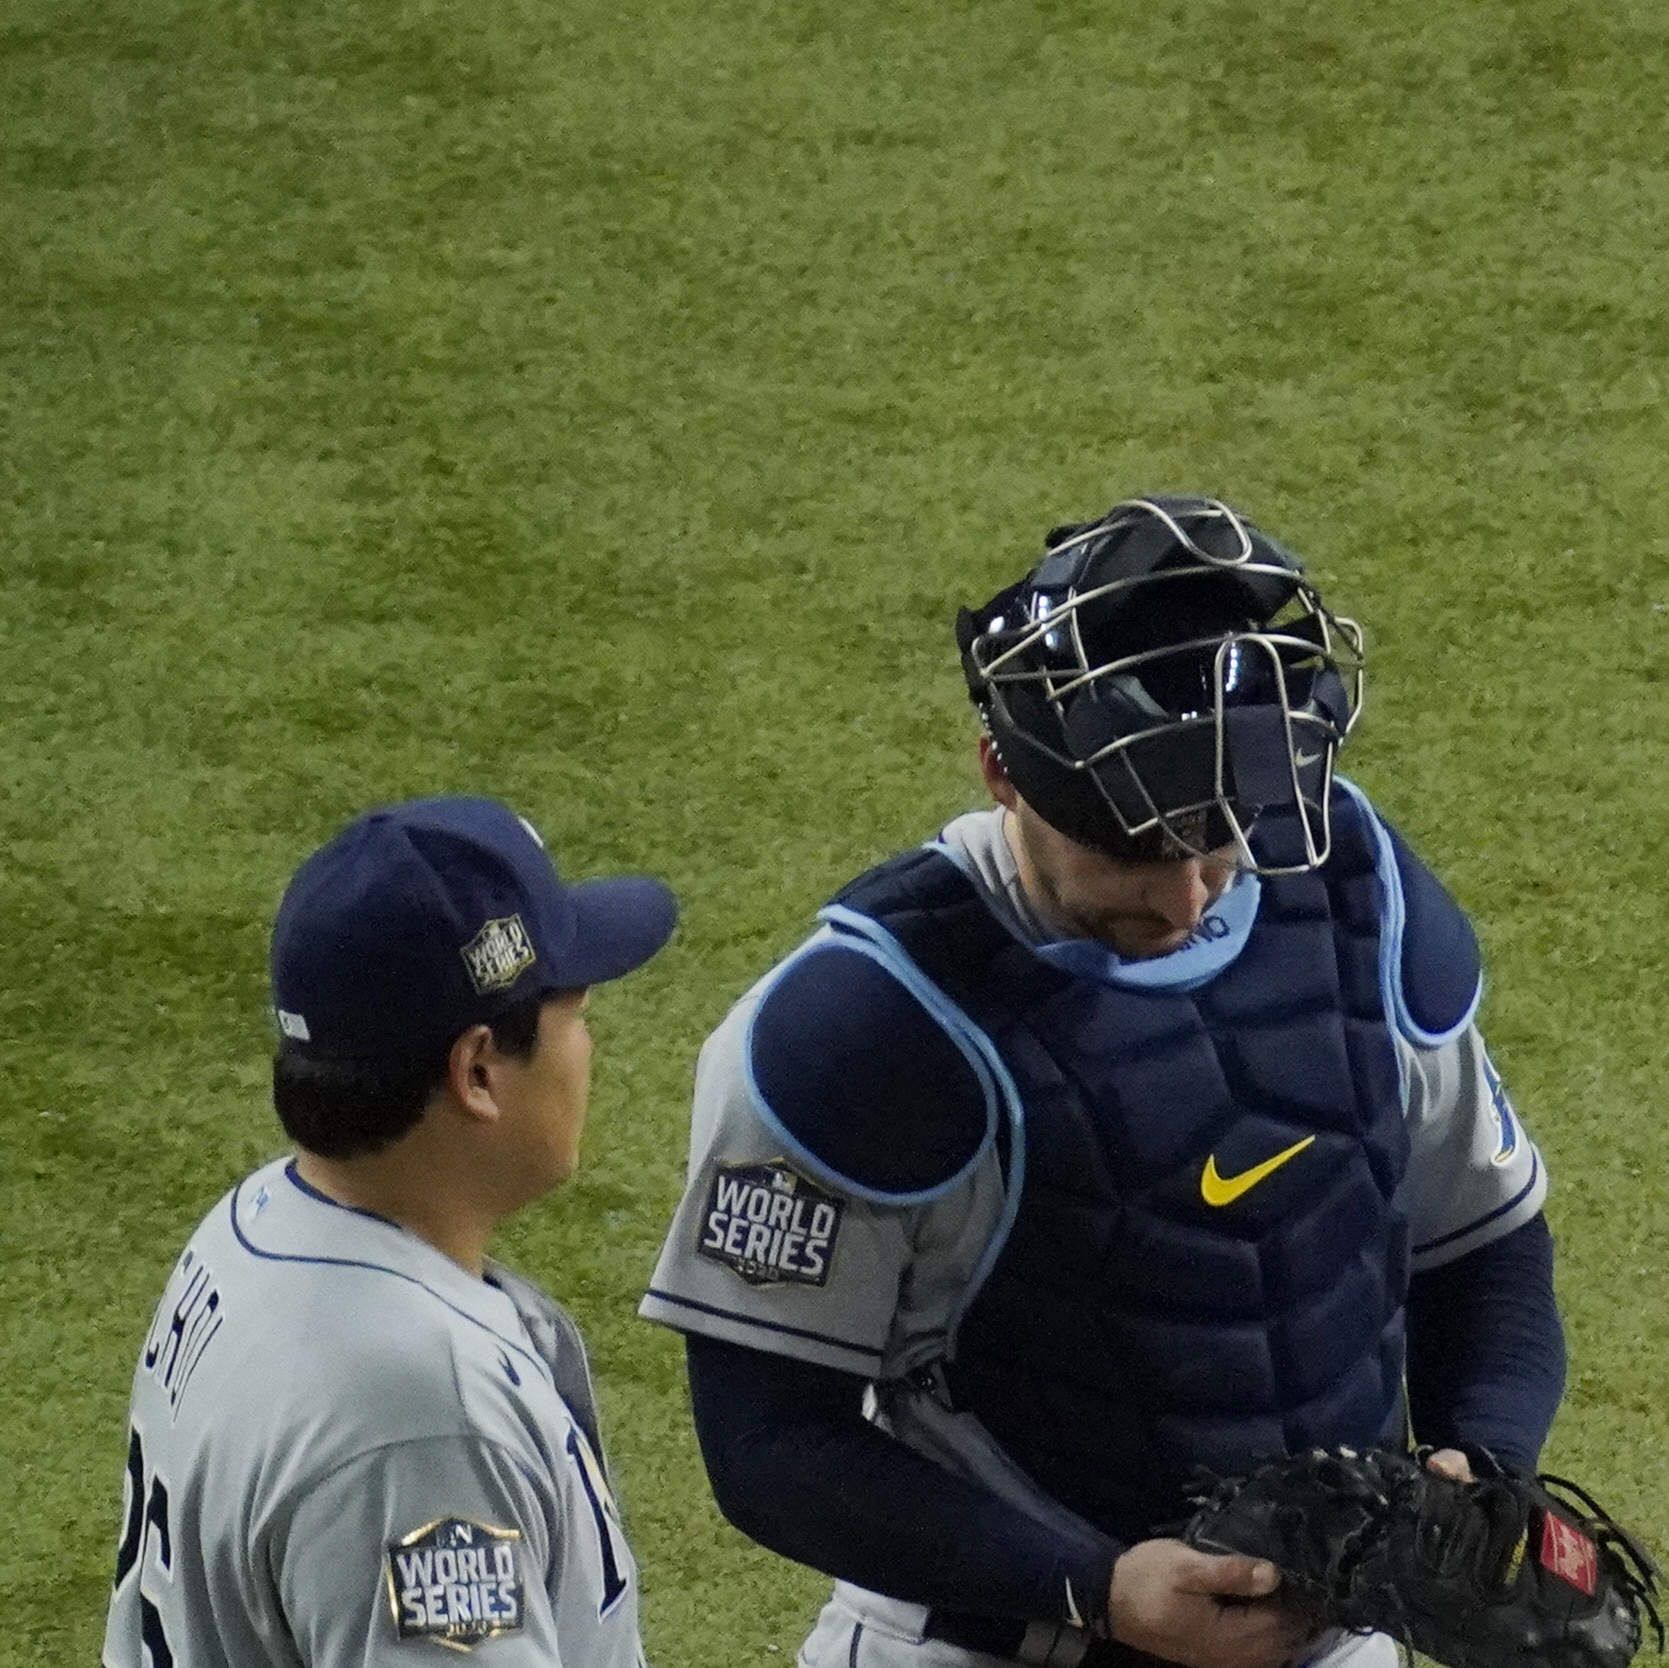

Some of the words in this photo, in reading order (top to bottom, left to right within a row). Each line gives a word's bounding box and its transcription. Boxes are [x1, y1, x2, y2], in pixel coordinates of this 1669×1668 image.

[716, 1175, 836, 1239] WORLD
[703, 1211, 828, 1276] SERIES
[396, 1543, 515, 1588] WORLD
[401, 1581, 518, 1627] SERIES
